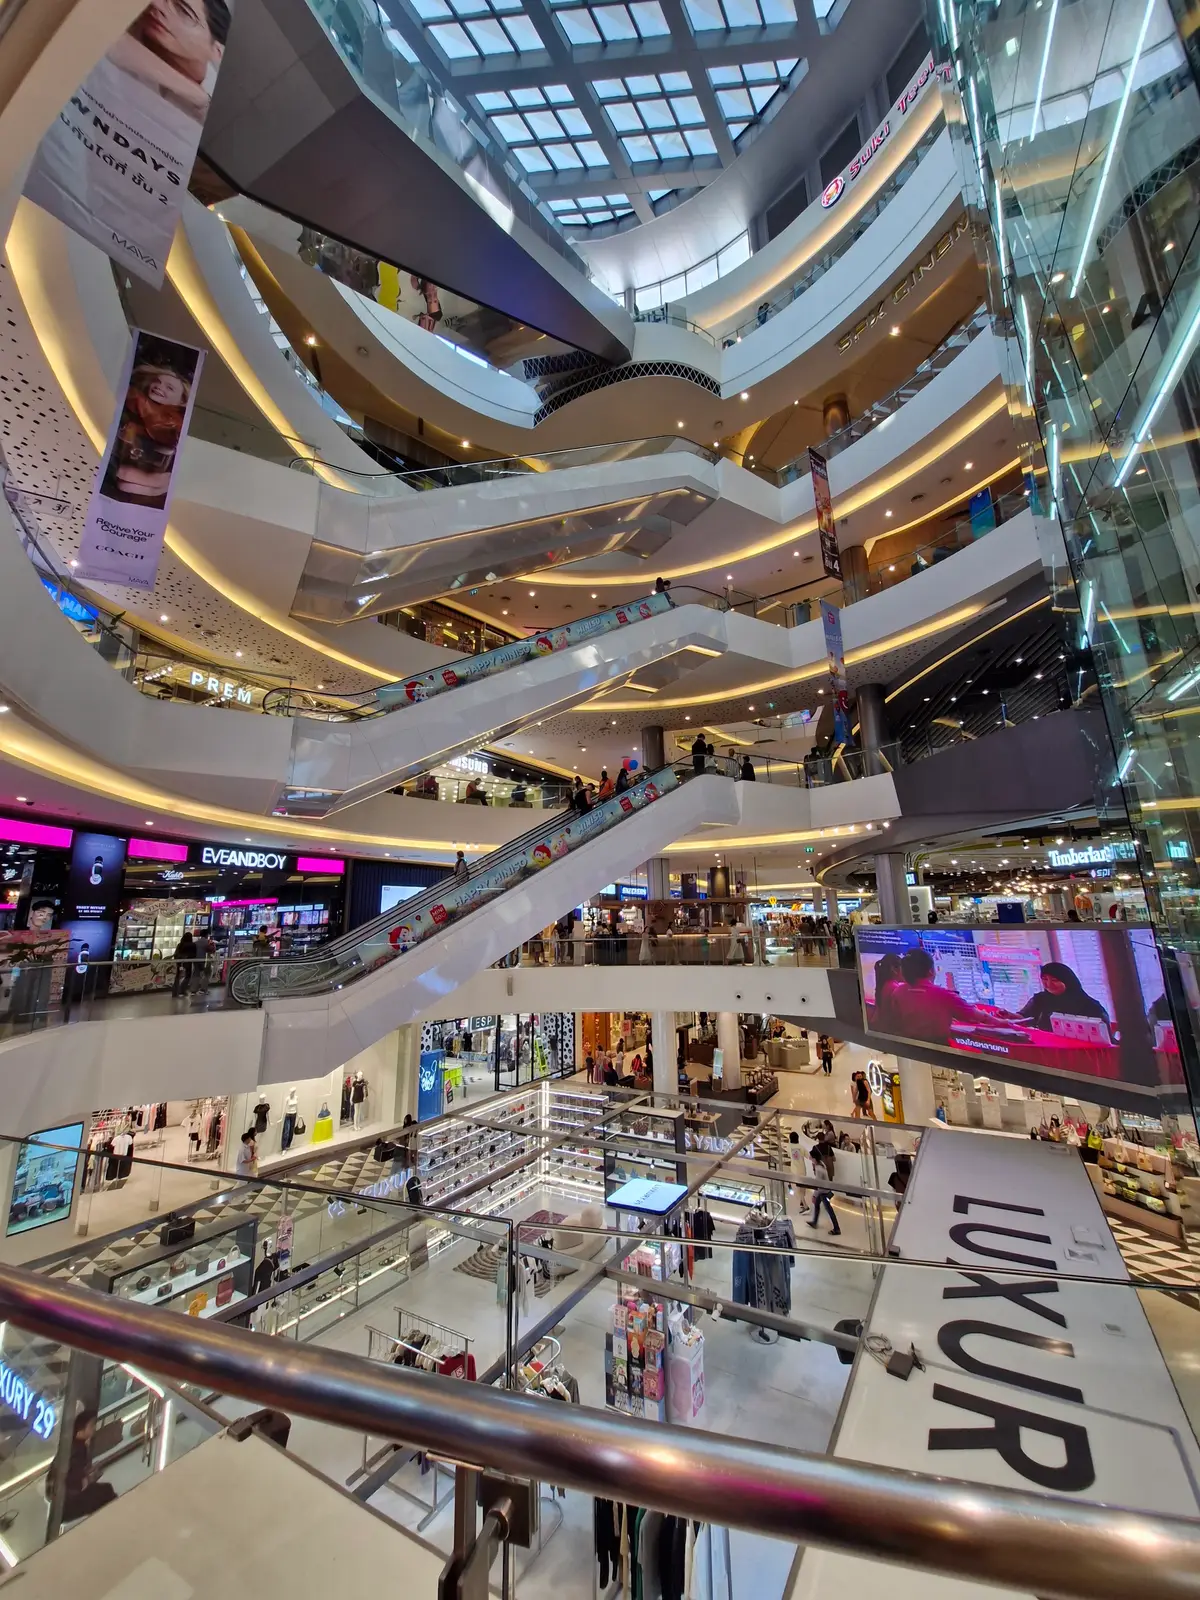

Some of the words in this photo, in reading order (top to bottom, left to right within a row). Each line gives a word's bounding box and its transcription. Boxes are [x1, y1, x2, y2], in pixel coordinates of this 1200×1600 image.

[849, 120, 891, 180] Suki
[158, 193, 169, 206] 2
[95, 517, 131, 533] Revive
[131, 527, 156, 539] Your
[100, 524, 149, 543] Courage
[95, 544, 145, 560] COACH
[463, 658, 498, 677] HAPPY
[499, 646, 532, 664] MINISO
[201, 847, 287, 869] EVEANDBOY
[454, 879, 491, 908] HAPPY
[493, 858, 529, 885] MINISO
[475, 1015, 493, 1028] ESP
[33, 1398, 56, 1440] 29
